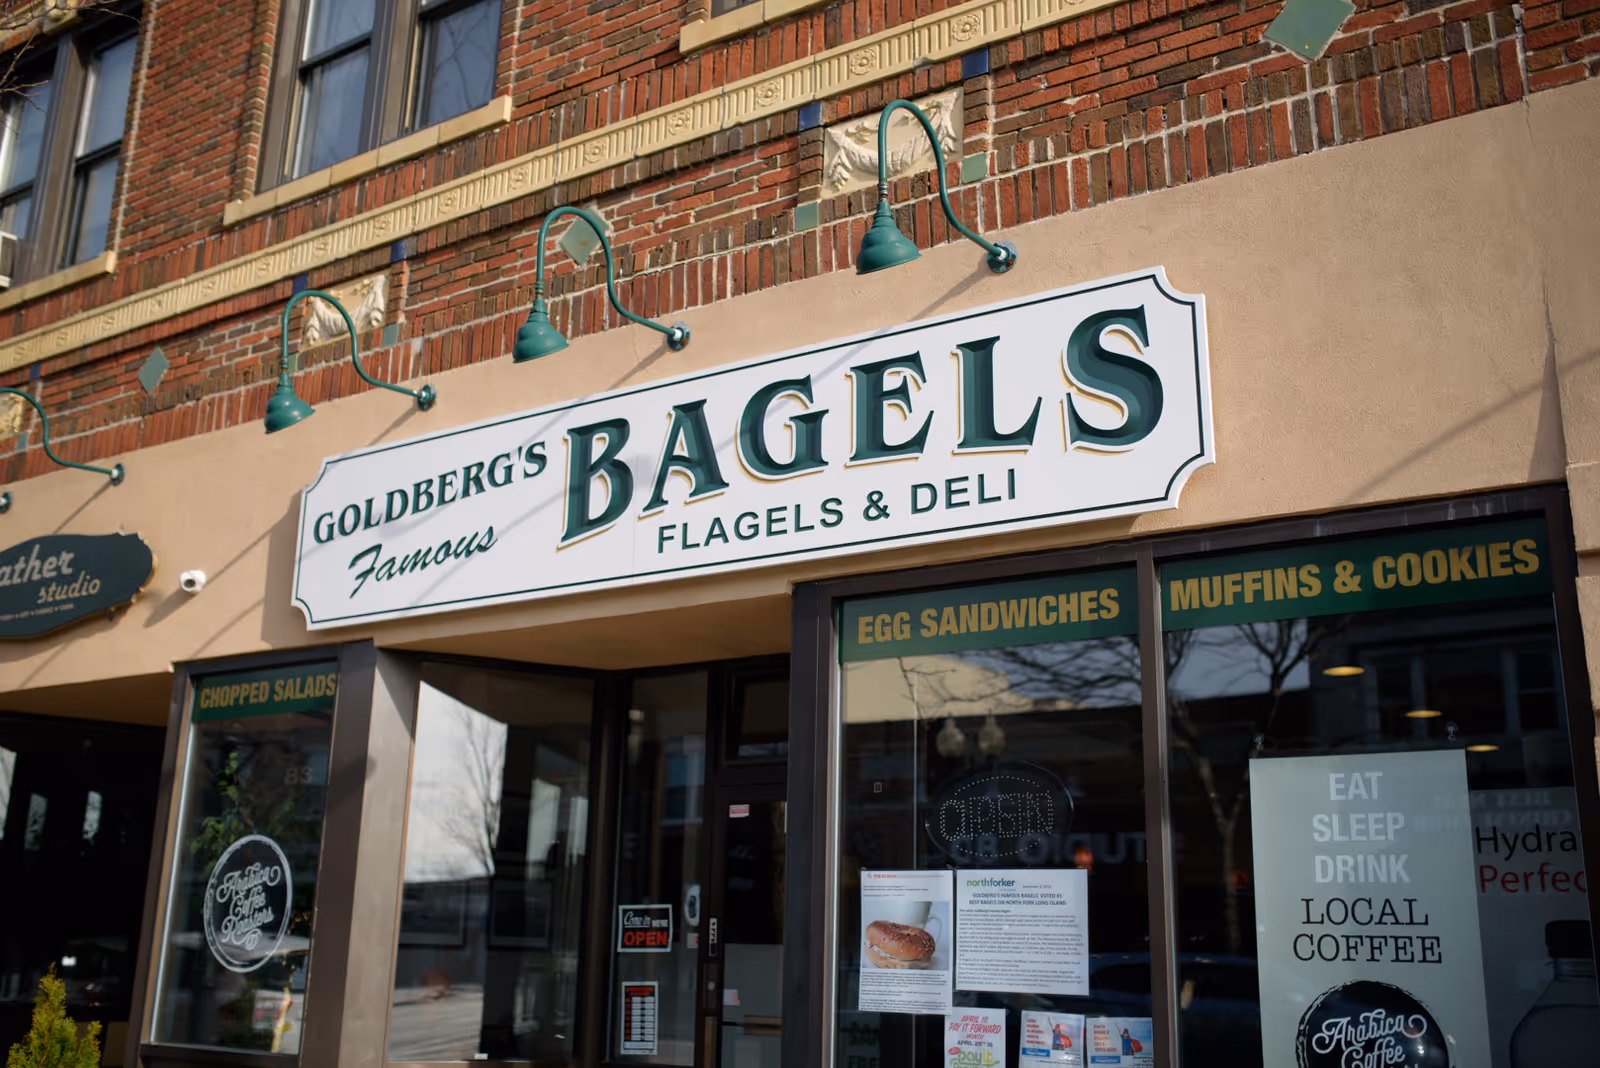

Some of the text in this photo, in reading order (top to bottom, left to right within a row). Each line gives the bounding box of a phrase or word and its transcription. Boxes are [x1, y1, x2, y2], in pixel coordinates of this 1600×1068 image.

[557, 303, 1164, 553] BAGELS
[313, 441, 548, 545] GOLDBERG'S
[657, 468, 1016, 553] FLAGELS & DELI
[348, 525, 498, 598] Famous
[1170, 538, 1540, 611] MUFFINS & COOKIES
[37, 569, 101, 604] studio
[858, 588, 1120, 645] EGG SANDWICHES
[200, 672, 337, 710] CHOPPED SALADS
[1328, 771, 1383, 801] EAT
[1312, 812, 1405, 842] SLEEP
[966, 877, 1016, 887] northforker
[1314, 854, 1412, 884] DRINK
[1300, 897, 1429, 926] LOCAL
[623, 930, 668, 947] OPEN
[1292, 934, 1443, 964] COFFEE
[1311, 1008, 1428, 1054] Arabica
